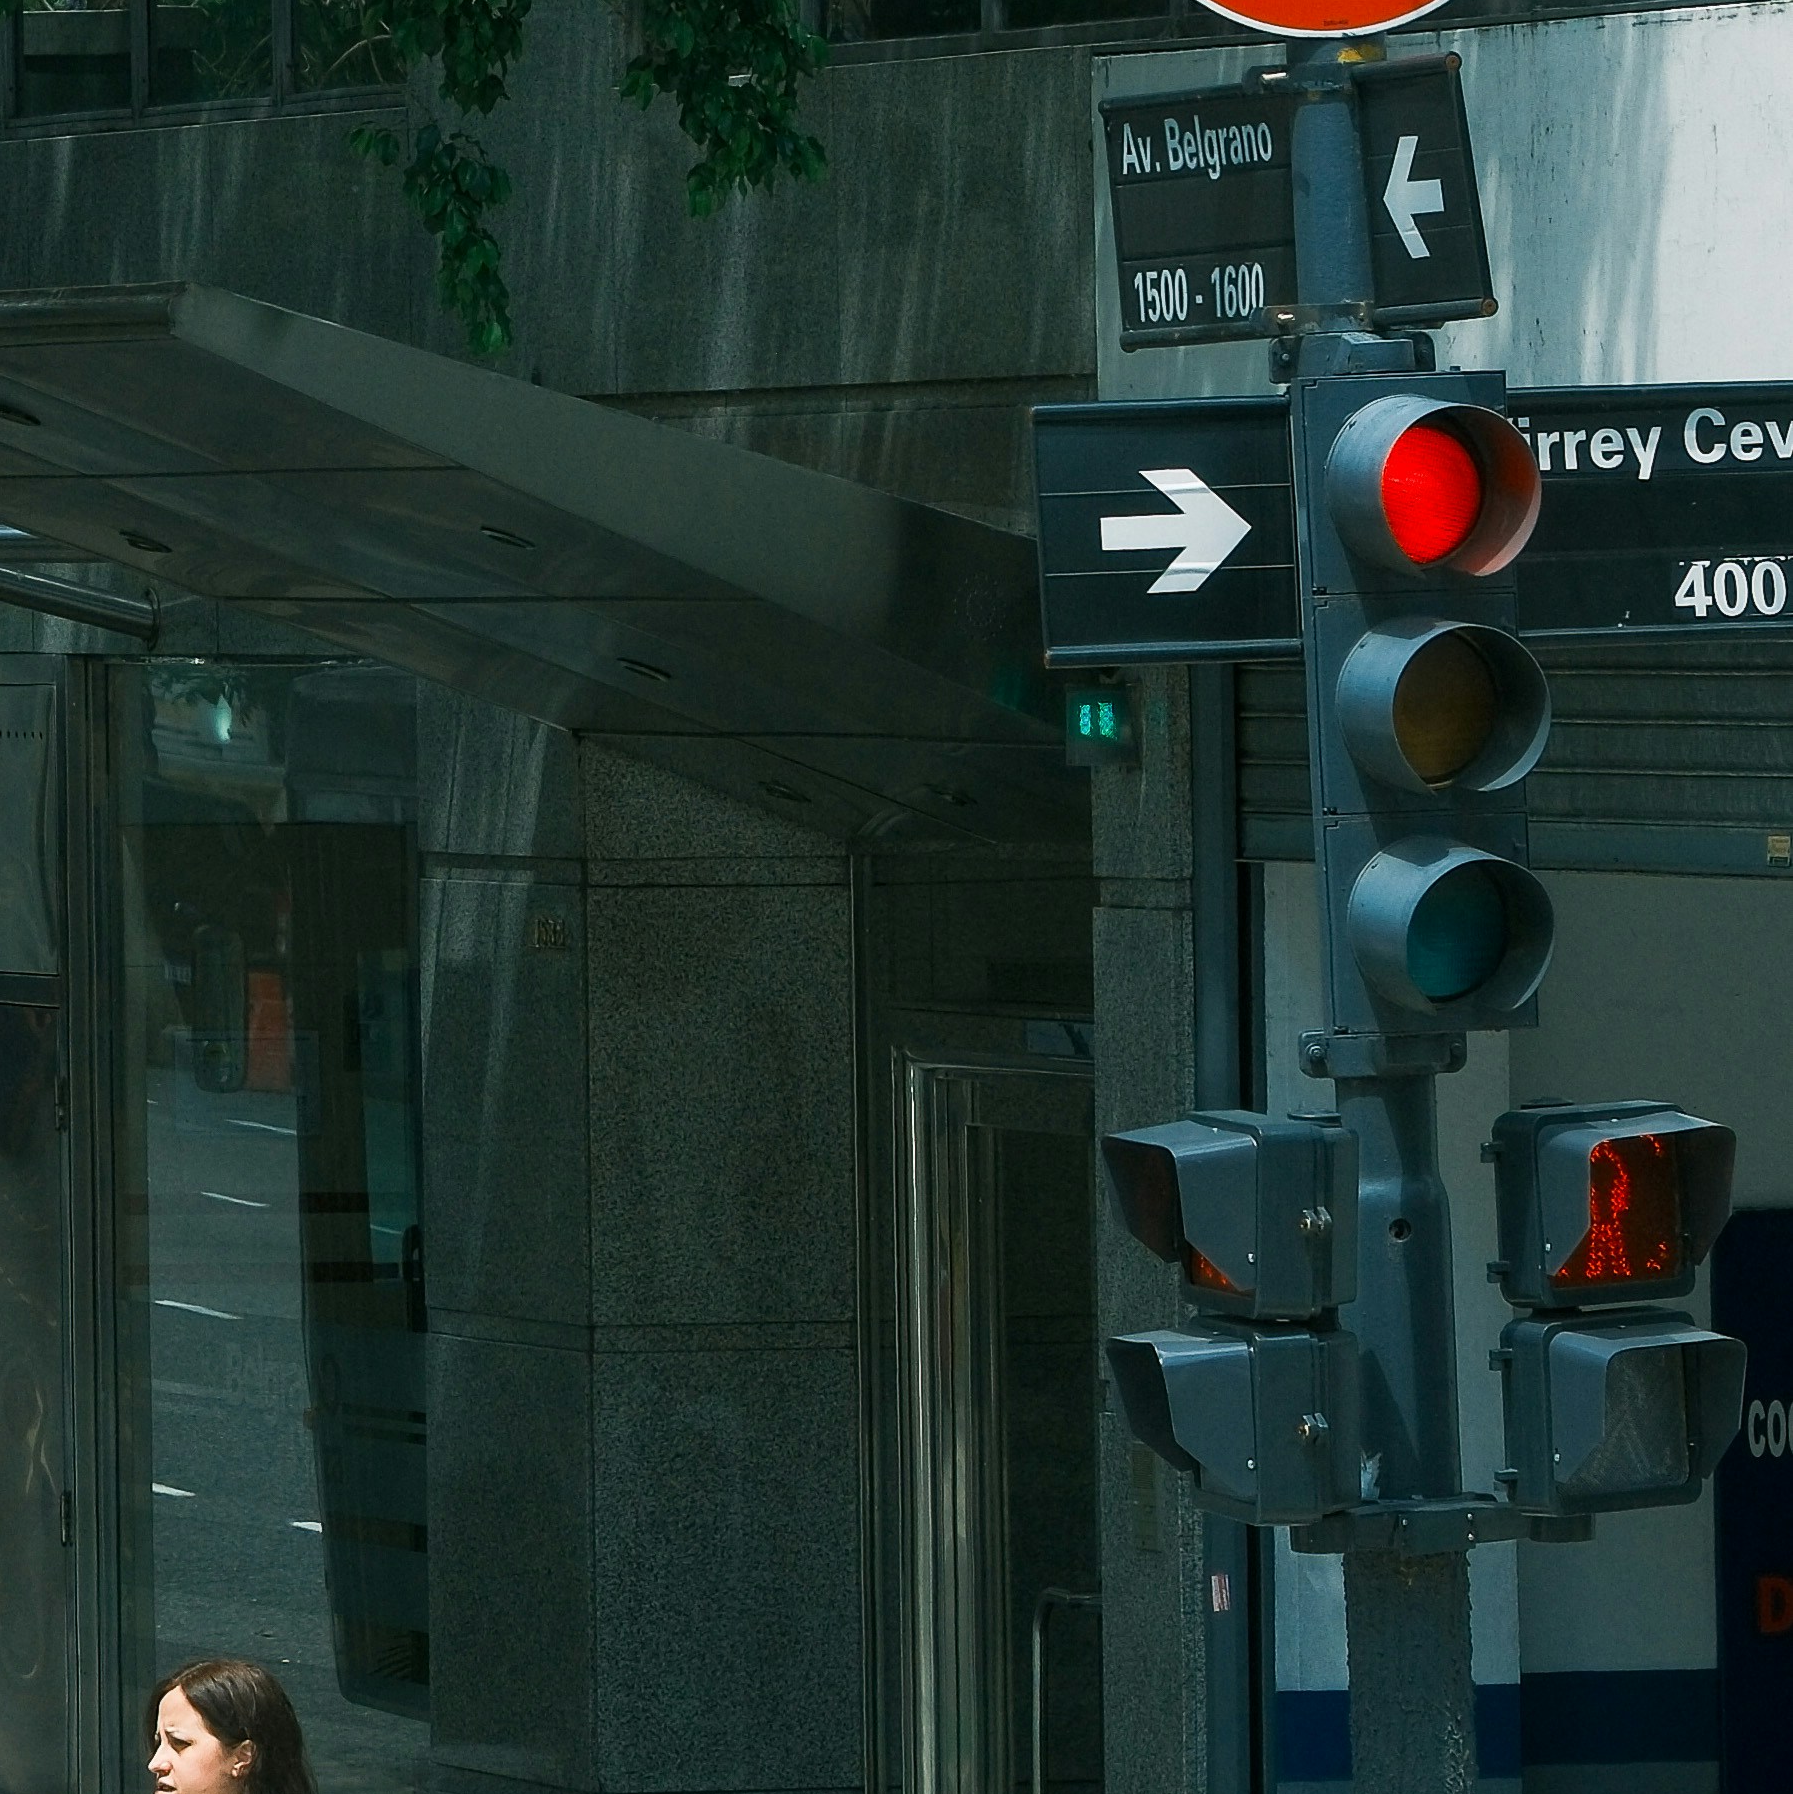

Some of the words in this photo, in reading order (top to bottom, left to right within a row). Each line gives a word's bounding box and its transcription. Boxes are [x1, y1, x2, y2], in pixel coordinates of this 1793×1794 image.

[1122, 122, 1160, 175] Av.
[1164, 115, 1272, 180] Belgrano
[1134, 268, 1188, 322] 1500
[1211, 262, 1264, 318] 1600
[1507, 417, 1662, 481] irrey
[1684, 407, 1793, 465] Cev
[1674, 560, 1786, 617] 400
